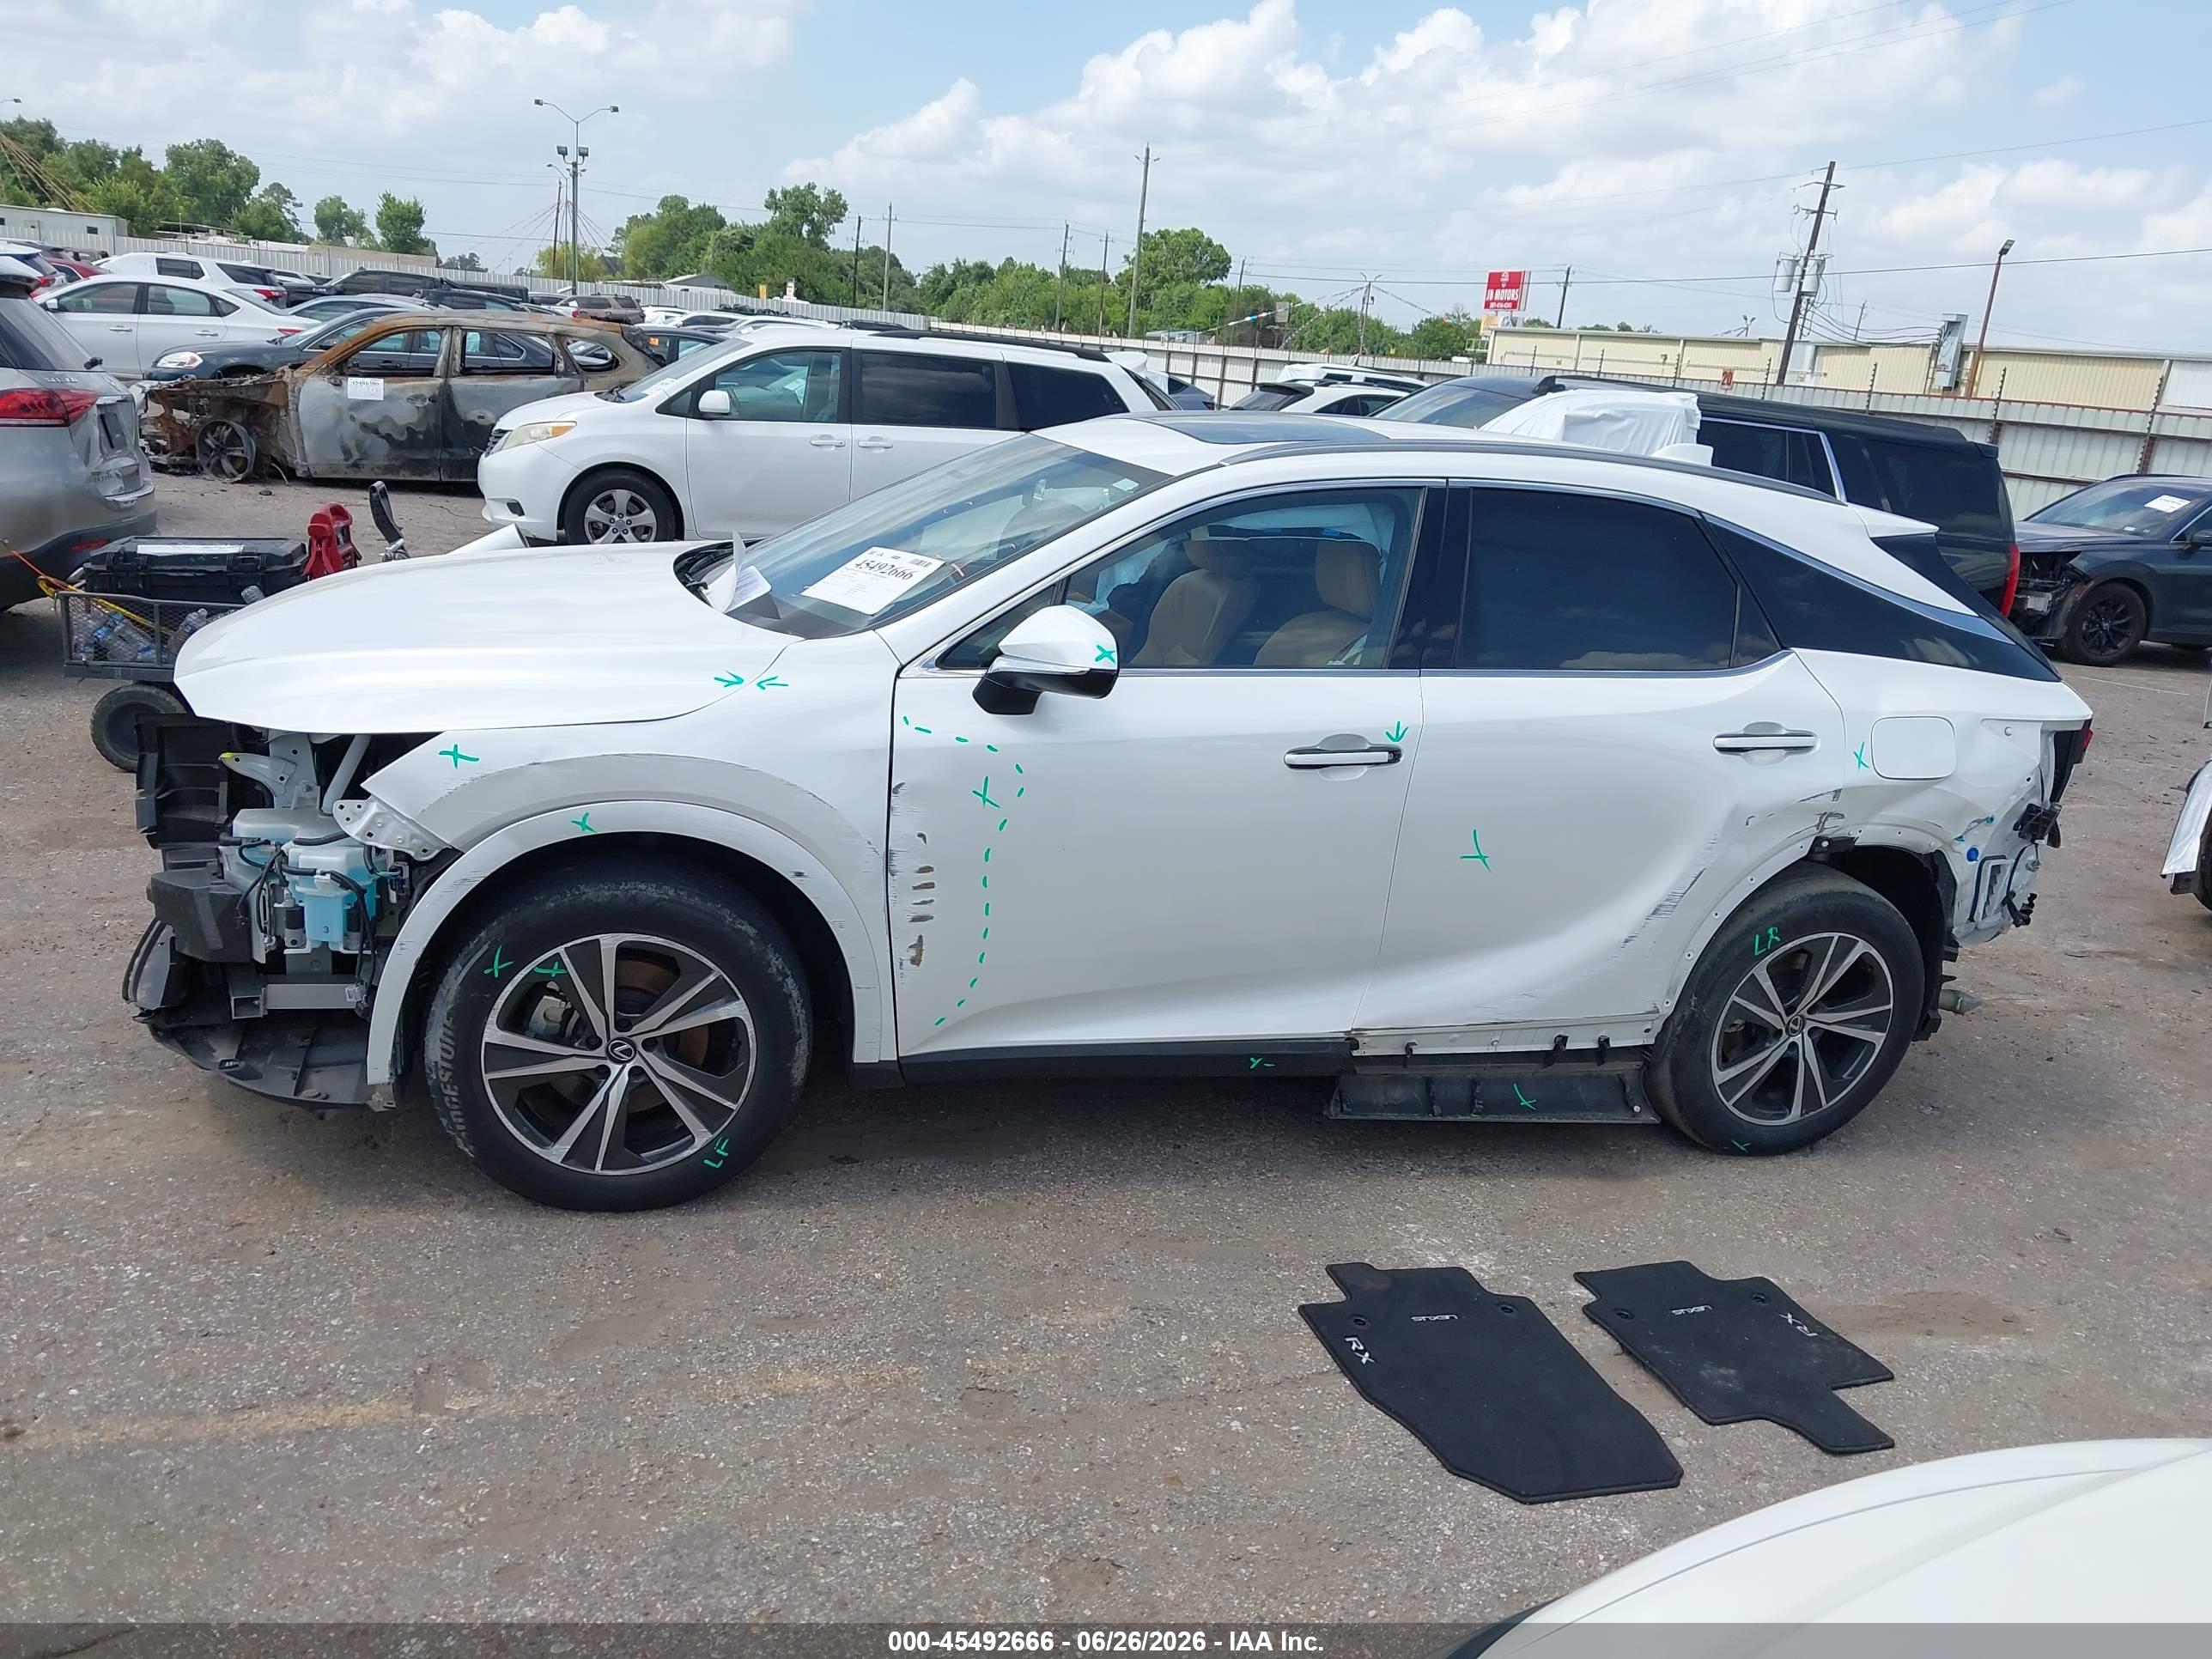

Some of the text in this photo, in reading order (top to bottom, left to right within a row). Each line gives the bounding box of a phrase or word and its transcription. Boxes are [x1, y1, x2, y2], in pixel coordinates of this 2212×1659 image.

[1486, 289, 1519, 301] JB MOTORS
[1721, 370, 1732, 386] 20
[854, 559, 920, 580] 45492666
[1754, 927, 1781, 956] LR
[703, 1137, 729, 1169] LF
[1671, 1304, 1712, 1316] LEXUS
[1778, 1312, 1819, 1336] RX
[1344, 1337, 1376, 1365] RX
